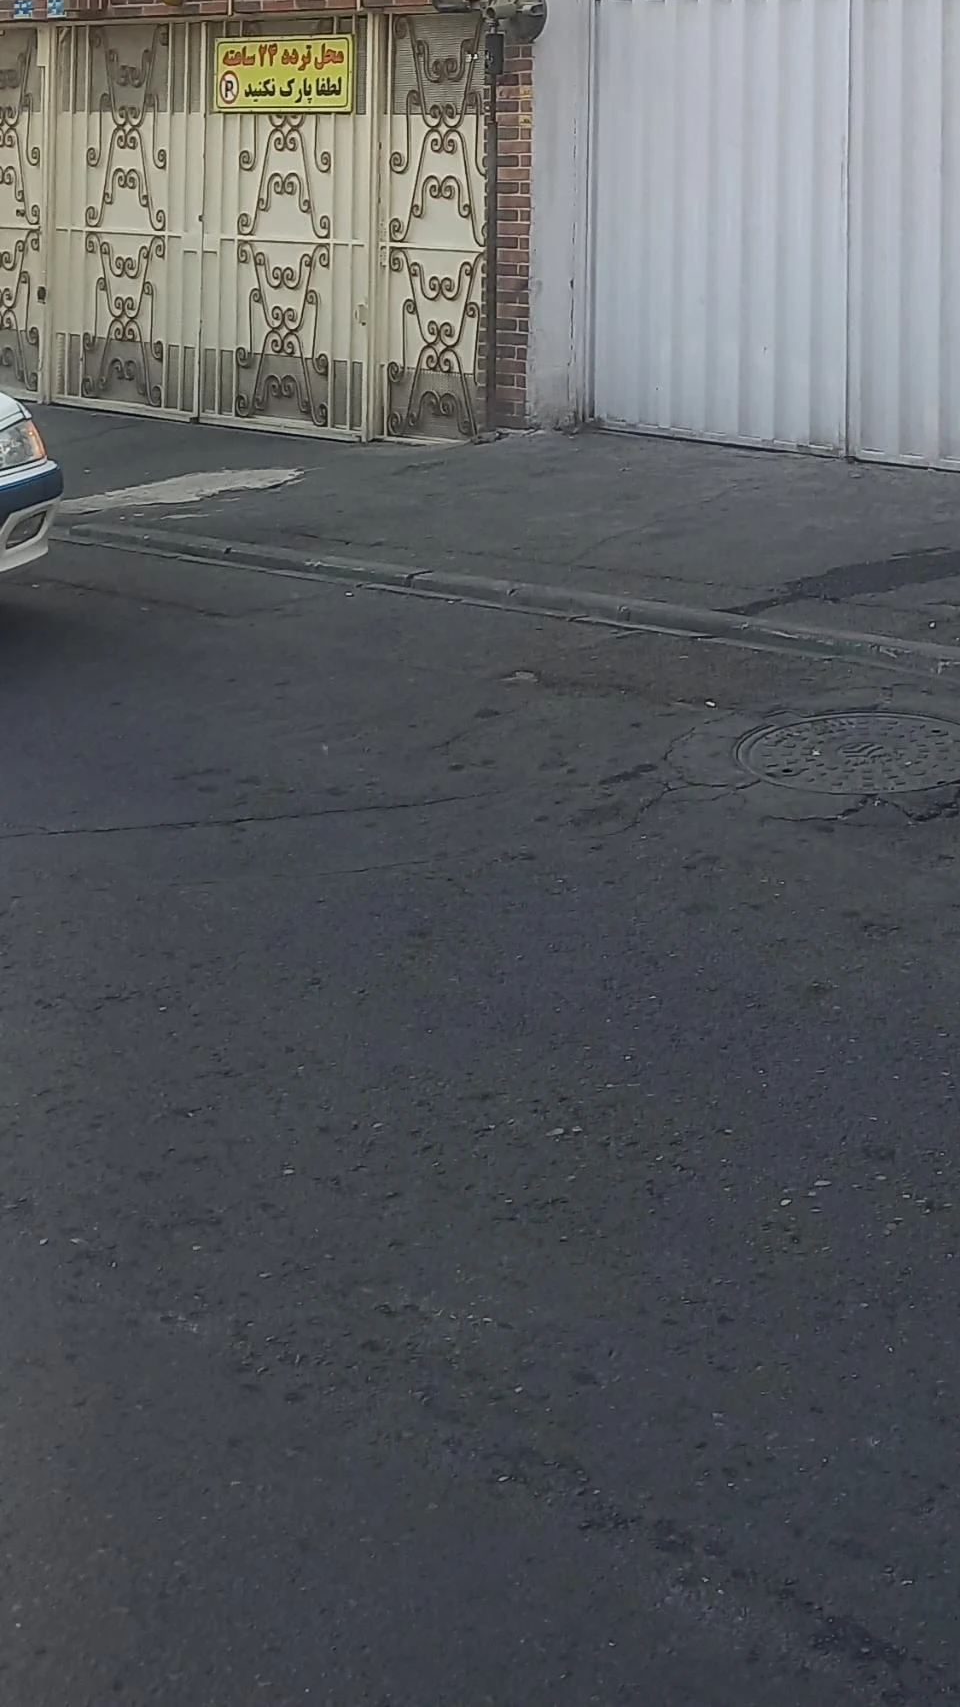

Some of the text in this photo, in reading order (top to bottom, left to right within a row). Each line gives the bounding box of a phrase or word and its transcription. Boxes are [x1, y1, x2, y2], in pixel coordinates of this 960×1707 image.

[222, 43, 344, 71] محل تردد ۲۴ ساعته
[244, 76, 342, 103] لطفا پارک نکنید
